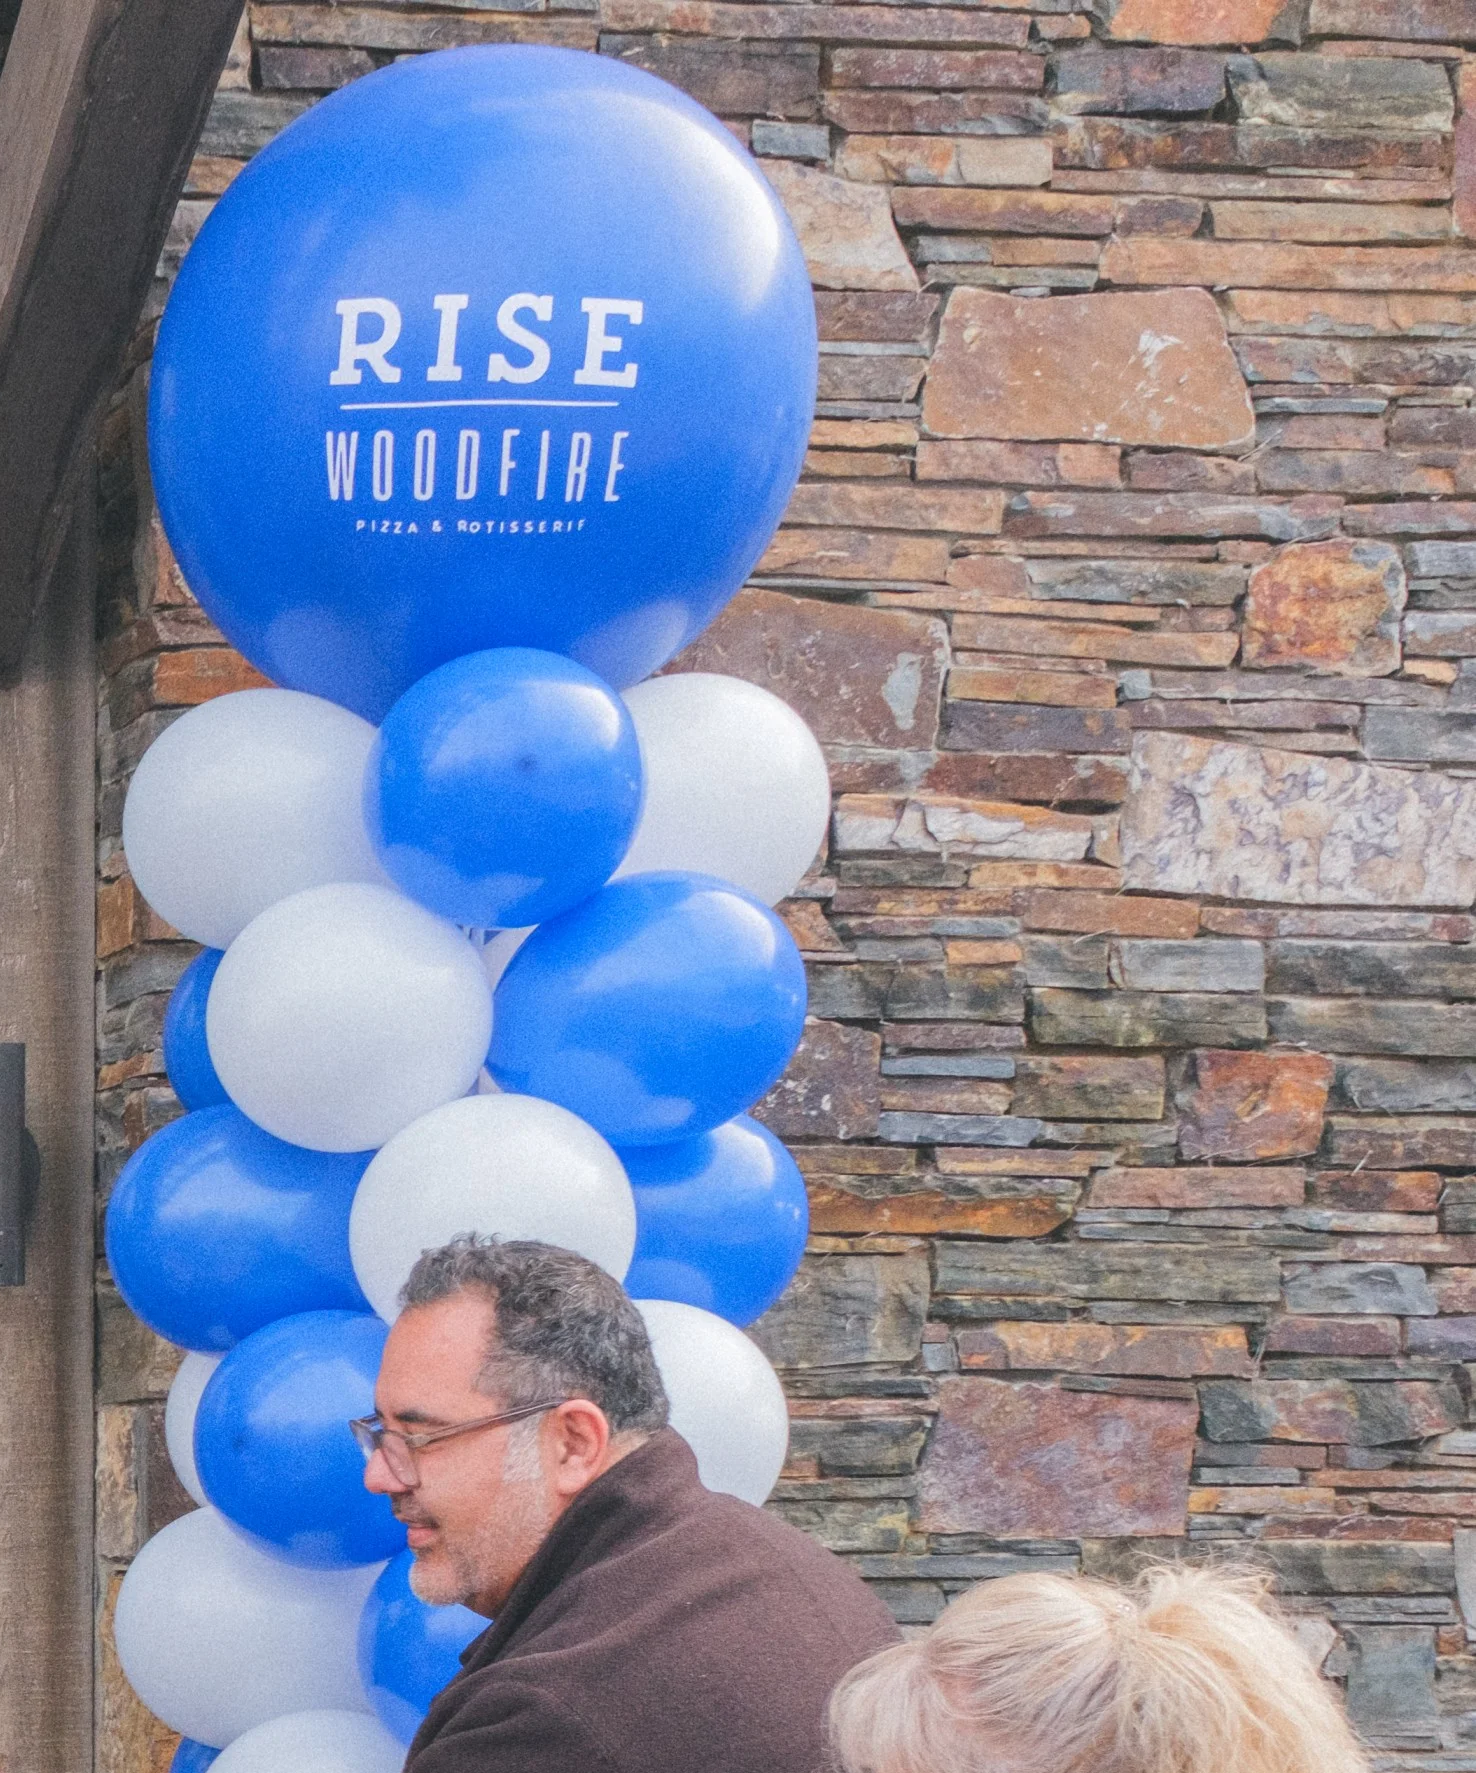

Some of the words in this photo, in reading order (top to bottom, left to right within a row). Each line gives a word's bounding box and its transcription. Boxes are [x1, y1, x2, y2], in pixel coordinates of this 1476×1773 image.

[329, 292, 644, 388] RISE
[325, 428, 630, 502] WOODFIRE
[355, 519, 419, 534] PIZZA
[431, 519, 443, 533] &
